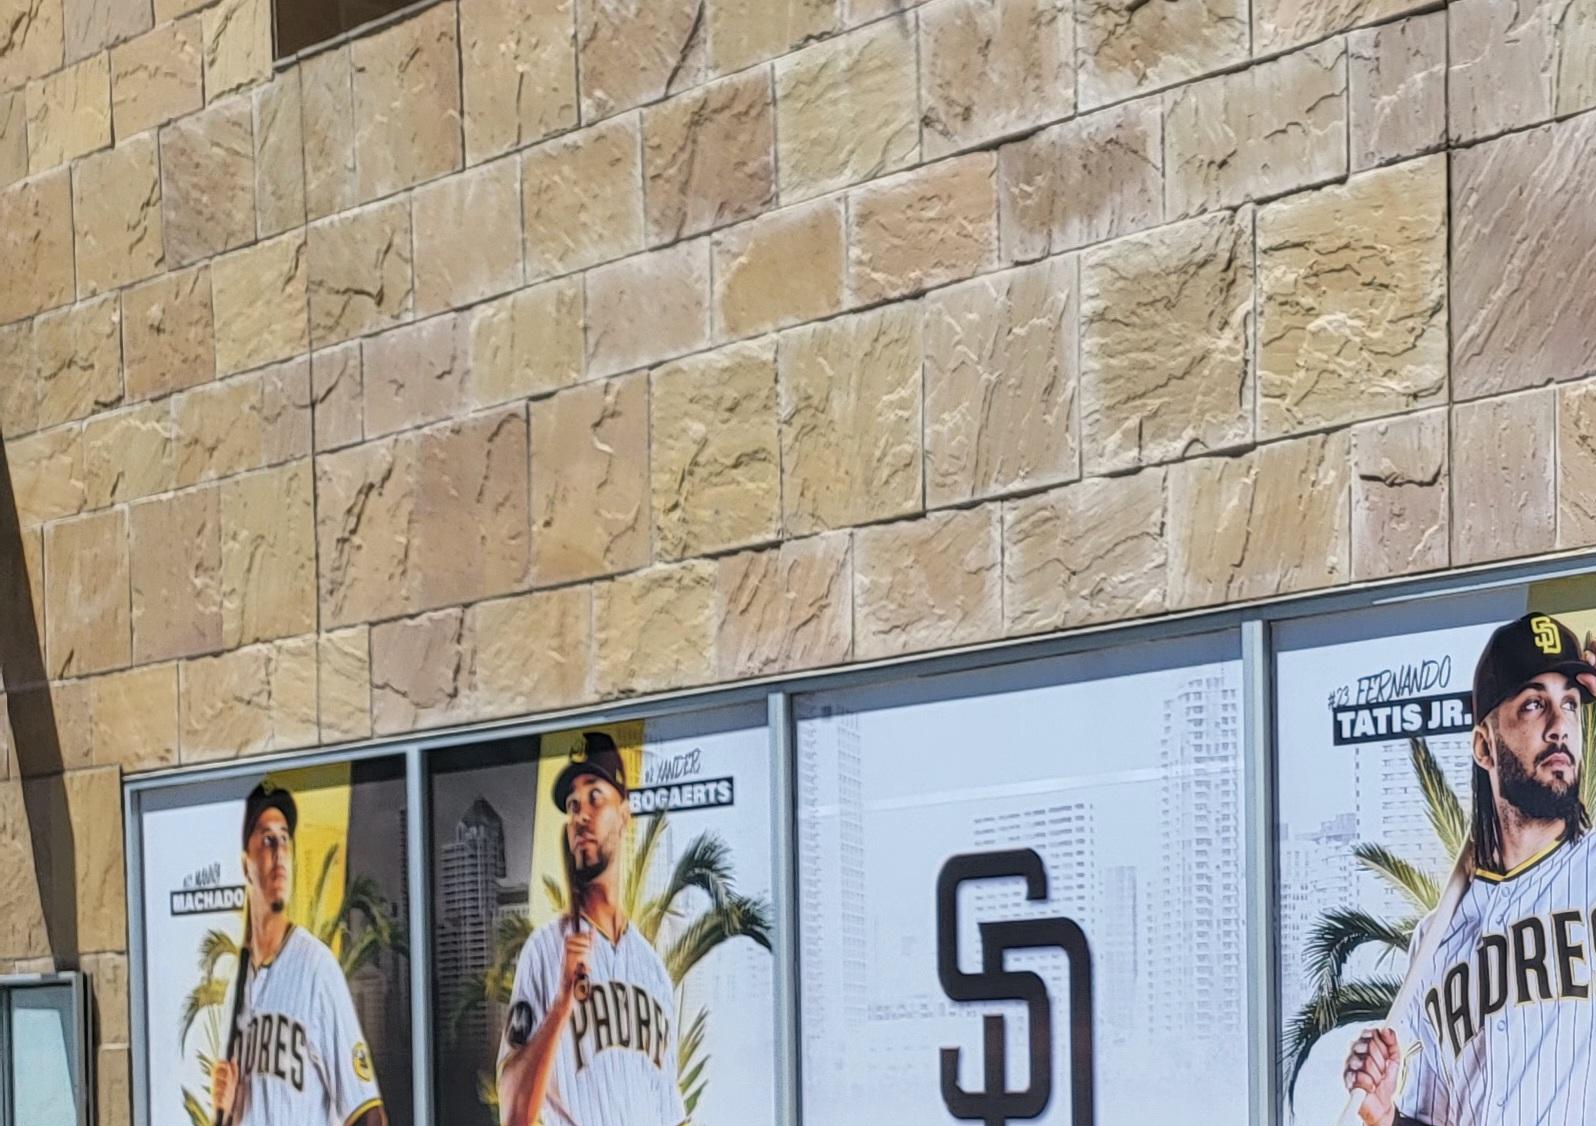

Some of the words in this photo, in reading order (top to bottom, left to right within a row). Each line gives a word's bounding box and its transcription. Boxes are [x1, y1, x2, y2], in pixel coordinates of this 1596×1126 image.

[1530, 616, 1562, 654] SD
[1328, 685, 1350, 710] #23
[1356, 654, 1451, 706] FERNANDO
[1337, 703, 1423, 739] TATIS
[1427, 699, 1472, 730] JR.
[629, 780, 733, 814] BOGAERTS
[172, 887, 245, 913] MACHADO
